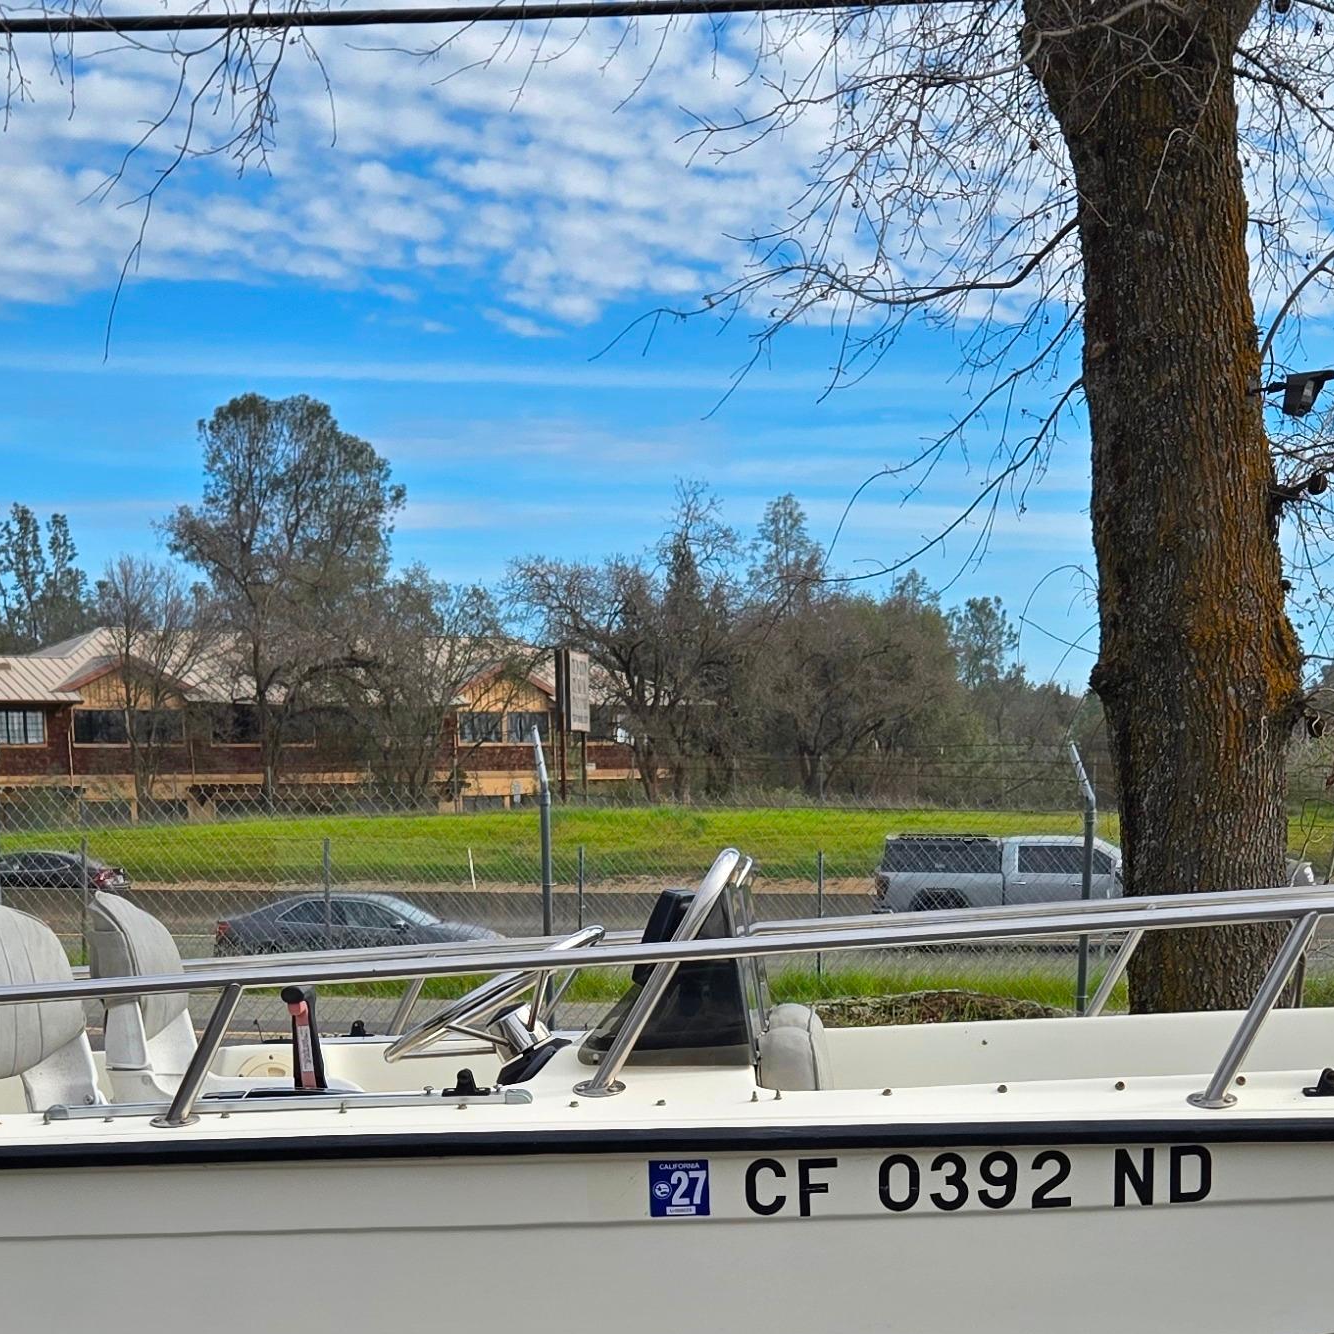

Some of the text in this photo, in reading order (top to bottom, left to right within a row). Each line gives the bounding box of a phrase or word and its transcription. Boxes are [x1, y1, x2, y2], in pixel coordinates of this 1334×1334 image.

[659, 1162, 700, 1170] CALIFORNIA
[745, 1144, 1212, 1216] CF 0392 ND
[670, 1169, 707, 1206] 27
